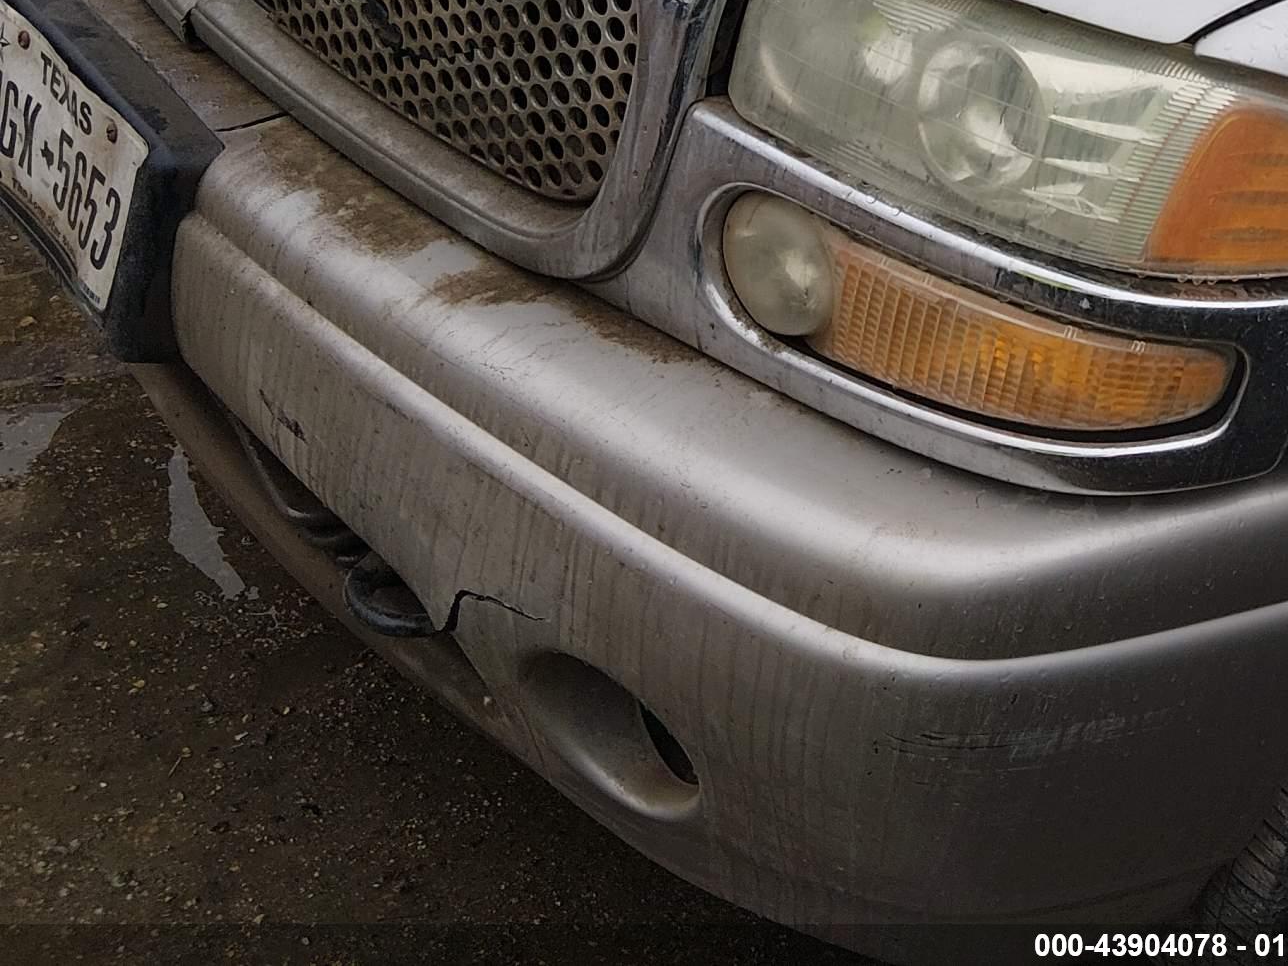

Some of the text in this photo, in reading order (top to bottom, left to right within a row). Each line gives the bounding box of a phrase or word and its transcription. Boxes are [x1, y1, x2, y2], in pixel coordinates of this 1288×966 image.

[40, 51, 92, 135] TEXAS
[0, 80, 41, 177] GX
[53, 128, 120, 270] 5653
